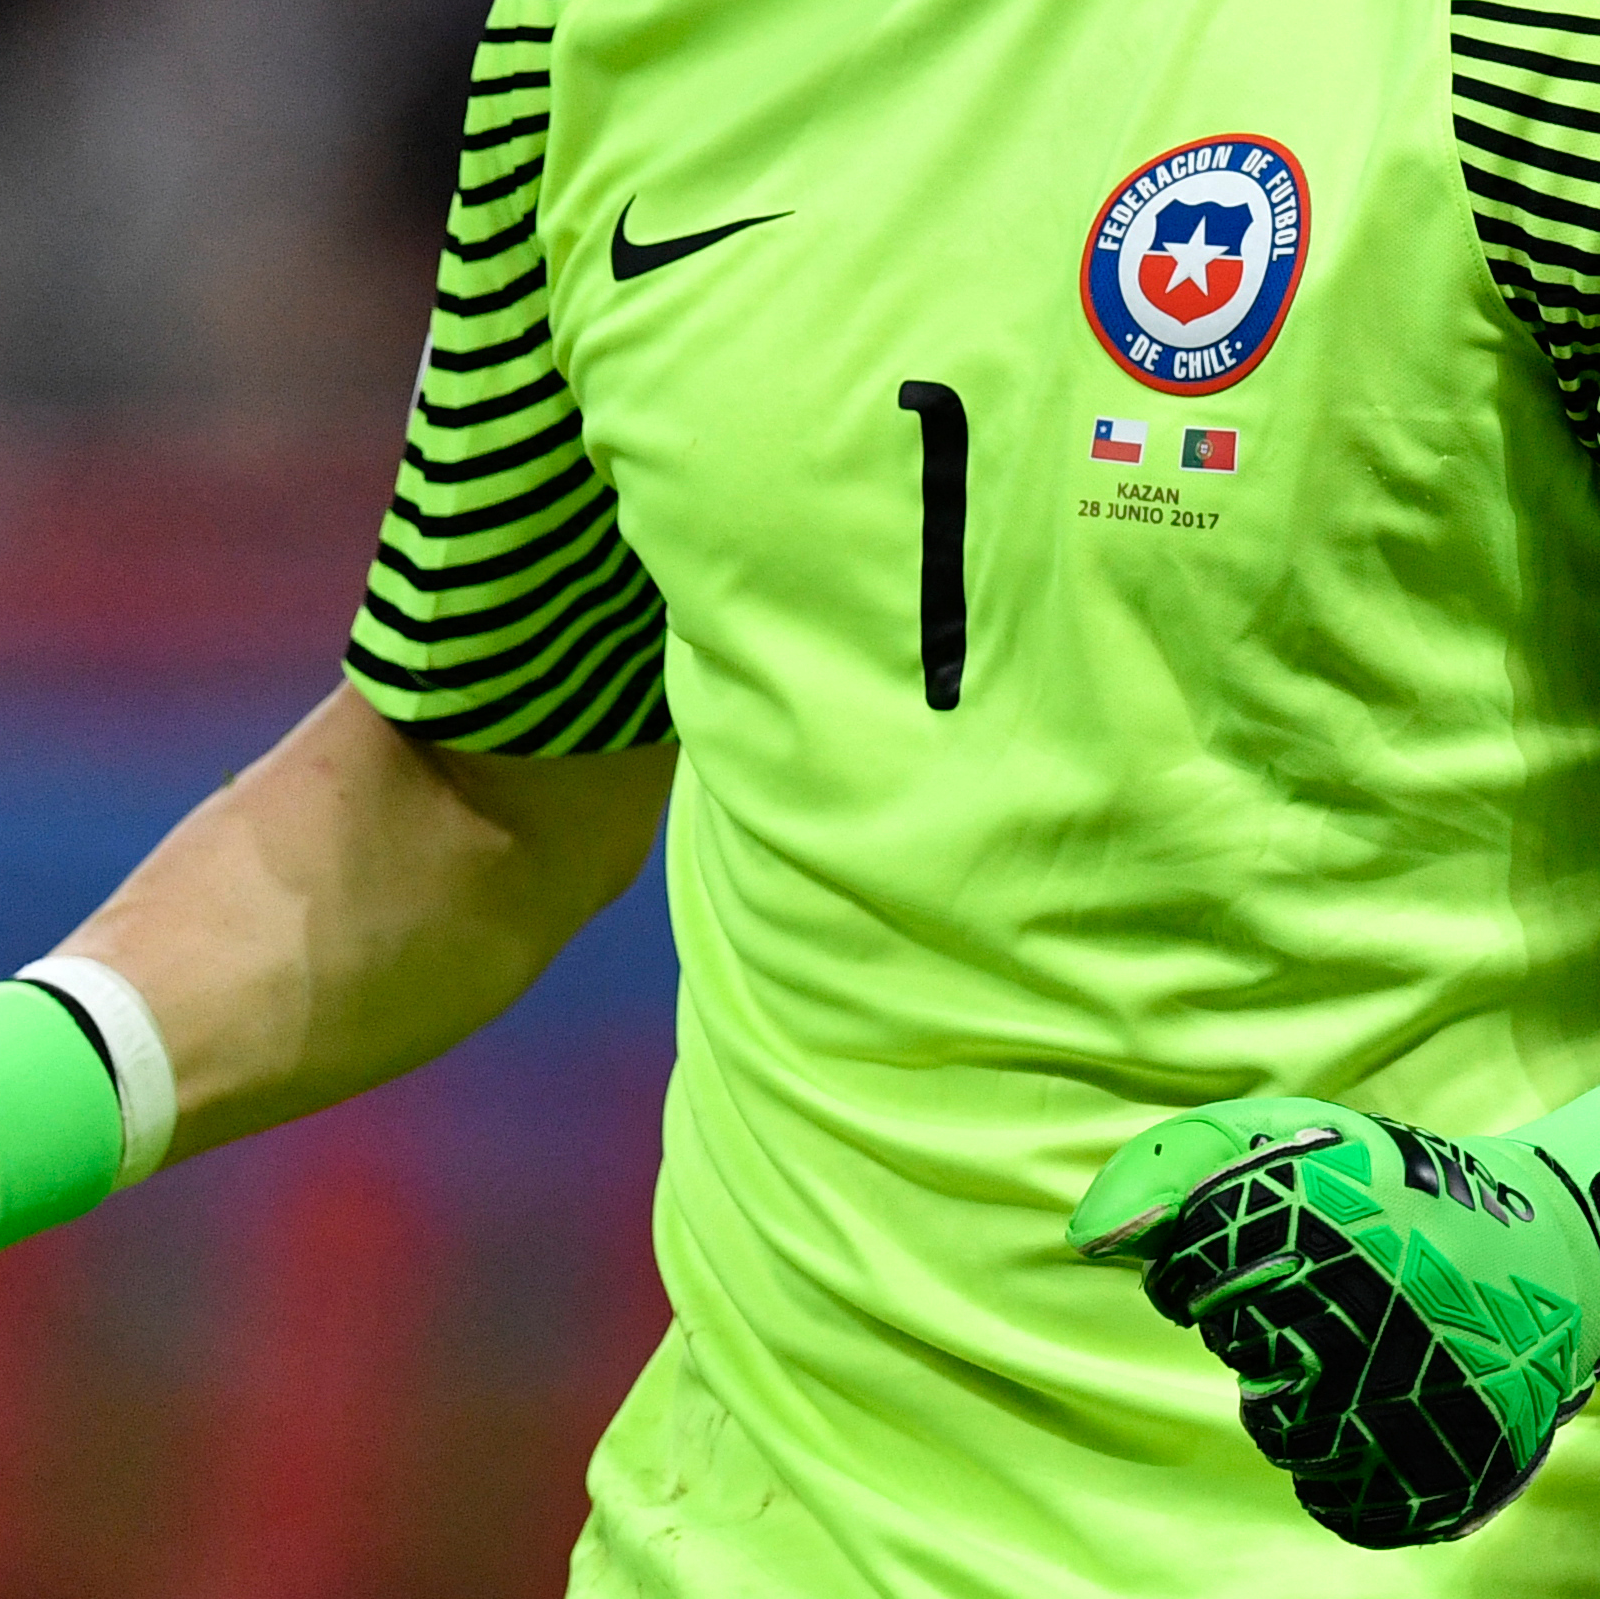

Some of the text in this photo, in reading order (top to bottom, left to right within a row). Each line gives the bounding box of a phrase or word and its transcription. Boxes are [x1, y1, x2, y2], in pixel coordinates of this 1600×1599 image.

[1097, 145, 1298, 262] FEDERACION DE FUTBOL
[1128, 333, 1237, 380] DE CHILE
[1077, 499, 1220, 530] 28 JUNIO 2017
[1116, 482, 1180, 505] KAZAN
[898, 380, 969, 711] 1
[1363, 1112, 1535, 1223] adid
